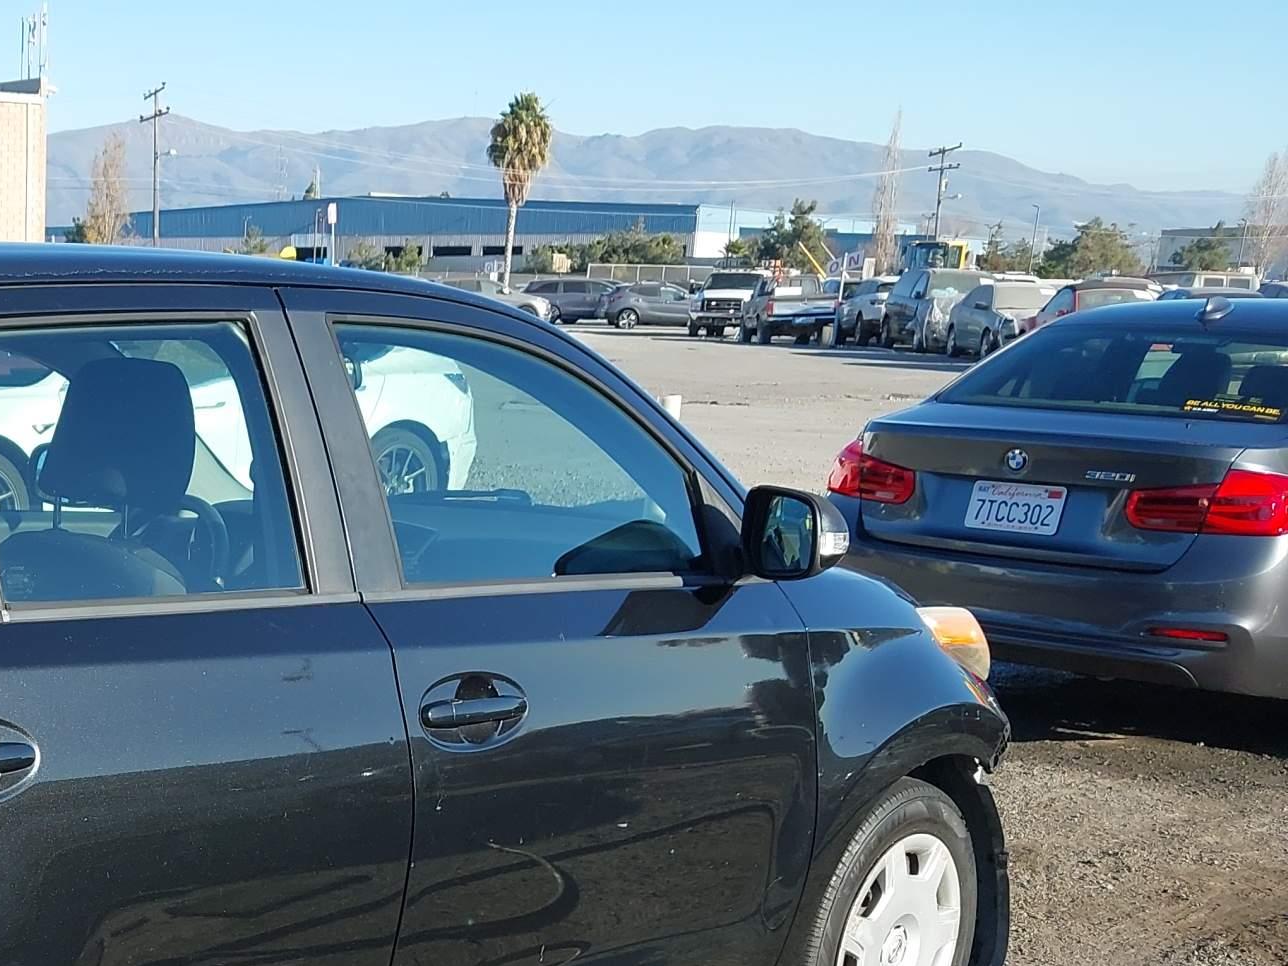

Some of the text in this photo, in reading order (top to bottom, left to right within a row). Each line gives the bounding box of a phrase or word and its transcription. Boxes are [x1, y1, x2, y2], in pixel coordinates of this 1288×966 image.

[848, 253, 860, 267] N
[1201, 400, 1220, 408] ALL
[1221, 402, 1243, 410] YOU
[1243, 405, 1265, 413] CAN
[1085, 470, 1136, 482] 320i
[991, 485, 1044, 499] California
[974, 498, 1055, 527] 7TCC302
